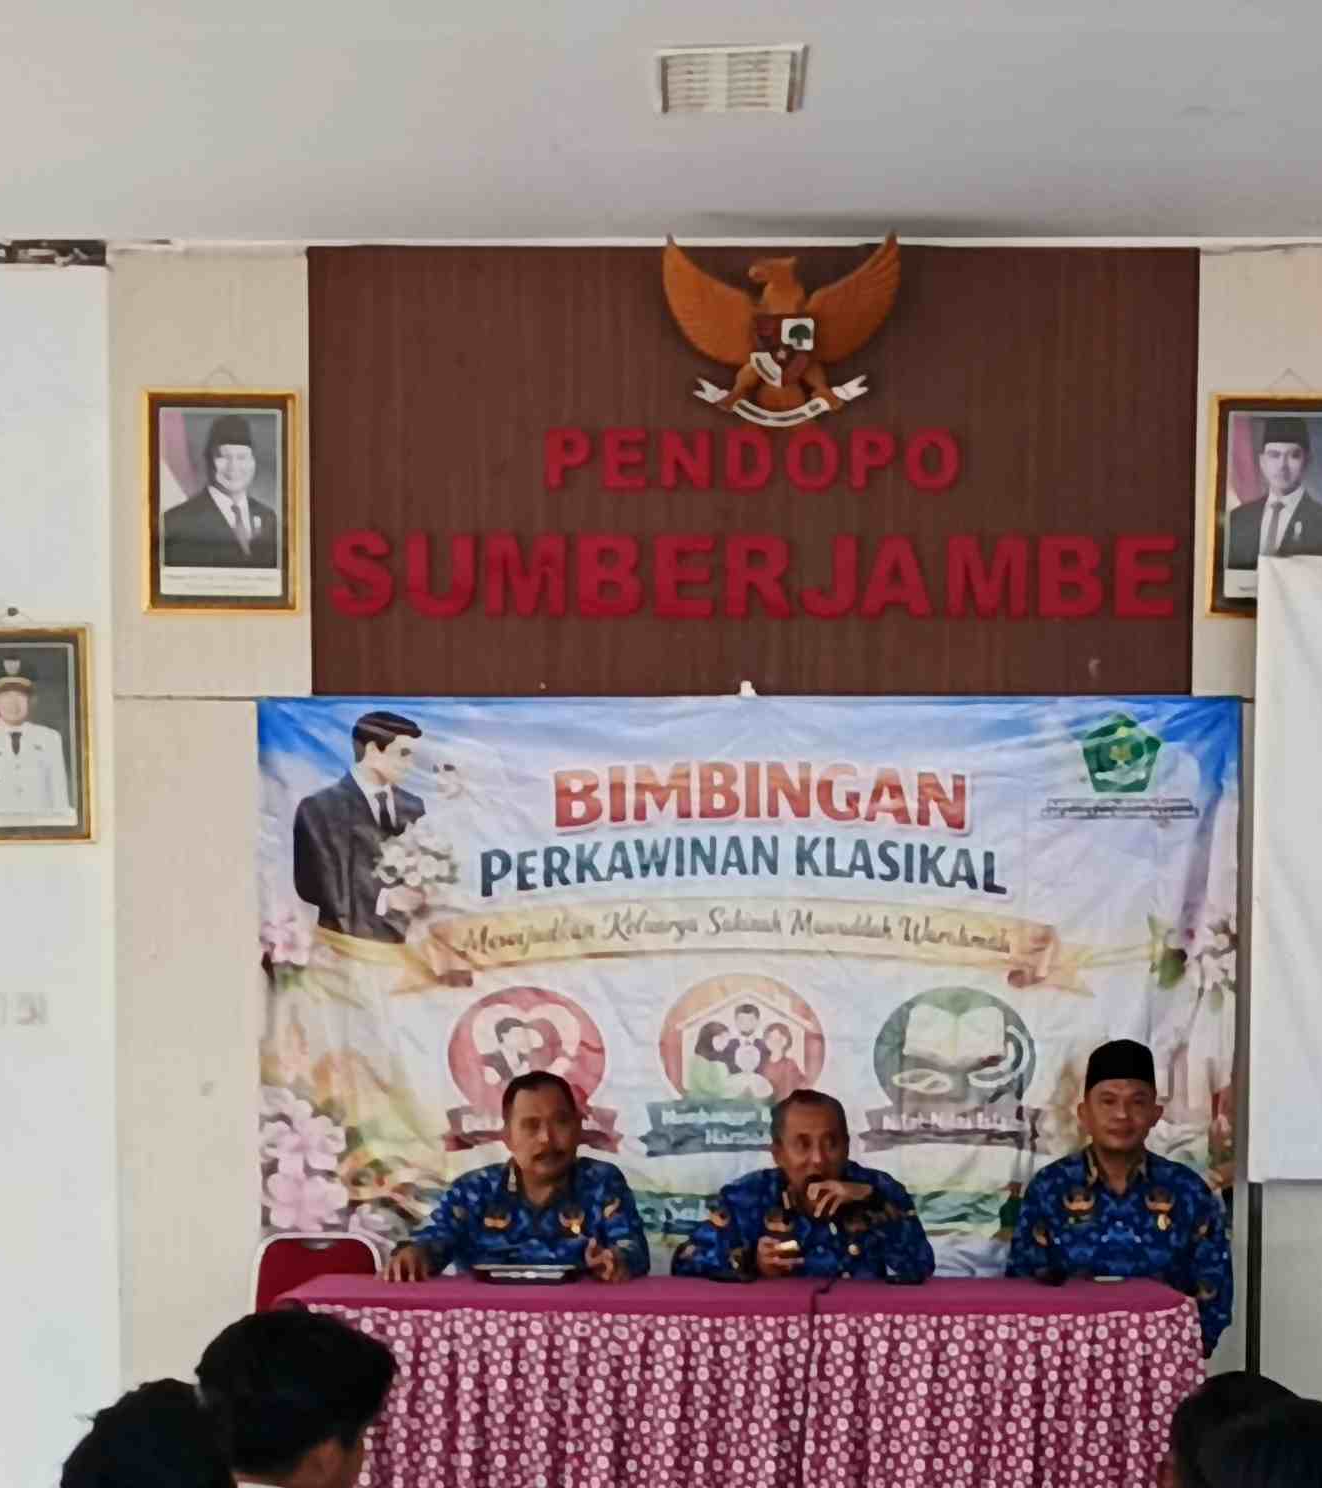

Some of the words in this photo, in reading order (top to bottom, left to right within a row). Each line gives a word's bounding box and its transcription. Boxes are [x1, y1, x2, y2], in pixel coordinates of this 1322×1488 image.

[544, 428, 961, 493] PENDOPO
[330, 530, 1179, 619] SUMBERJAMBE
[553, 761, 966, 830] BIMBINGAN
[480, 836, 779, 897] PERKAWINAN
[795, 835, 1007, 895] KLASIKAL
